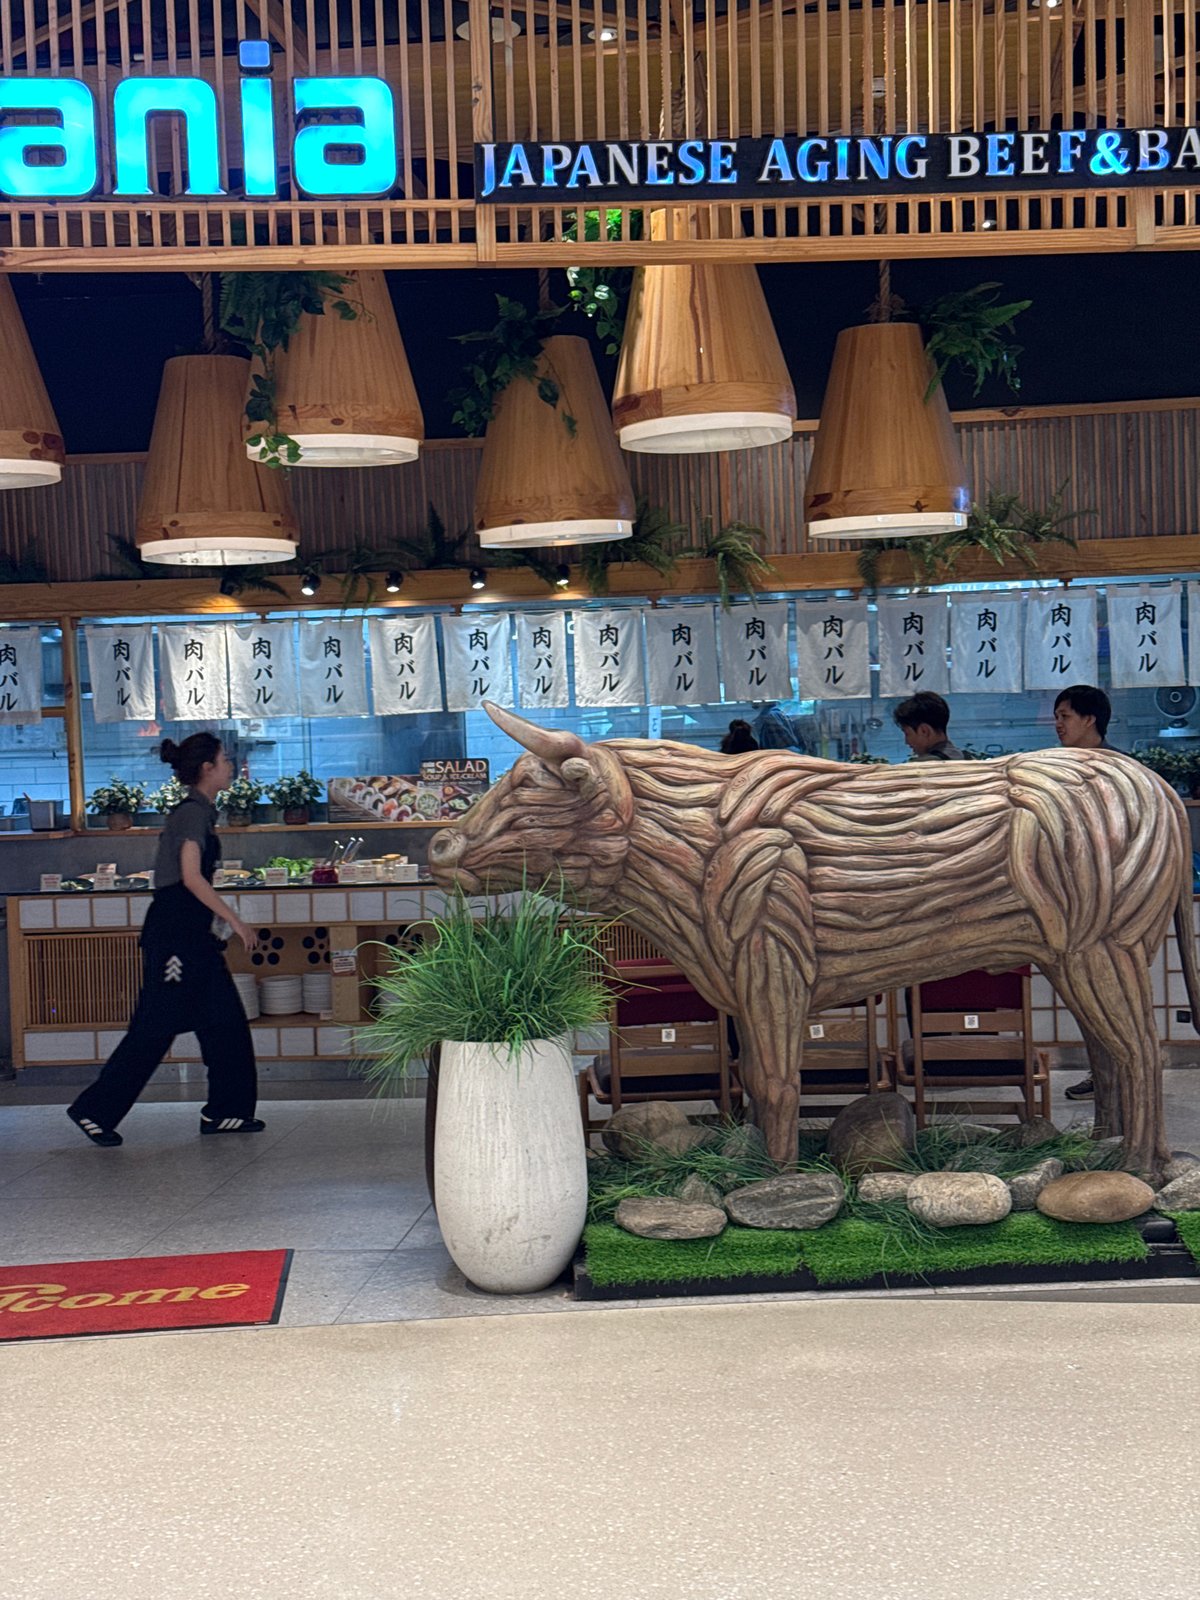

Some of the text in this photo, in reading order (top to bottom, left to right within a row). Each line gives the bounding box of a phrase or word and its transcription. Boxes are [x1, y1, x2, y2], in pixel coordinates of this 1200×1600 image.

[0, 39, 397, 197] ania
[481, 141, 738, 197] JAPANESE
[757, 136, 928, 184] AGING
[252, 637, 274, 705] 肉バル
[323, 636, 344, 704] 肉バル
[393, 632, 416, 700] 肉バル
[468, 628, 490, 696] 肉バル
[532, 626, 553, 695] 肉バル
[599, 623, 620, 692] 肉バル
[671, 623, 694, 692] 肉バル
[745, 616, 767, 686] 肉バル
[822, 614, 844, 685] 肉バル
[902, 611, 925, 682] 肉バル
[977, 608, 998, 679] 肉バル
[1050, 603, 1072, 674] 肉バル
[1135, 601, 1158, 673] 肉バル
[112, 638, 131, 706] 肉バル
[183, 638, 205, 706] 肉バル
[435, 760, 487, 773] SALAD
